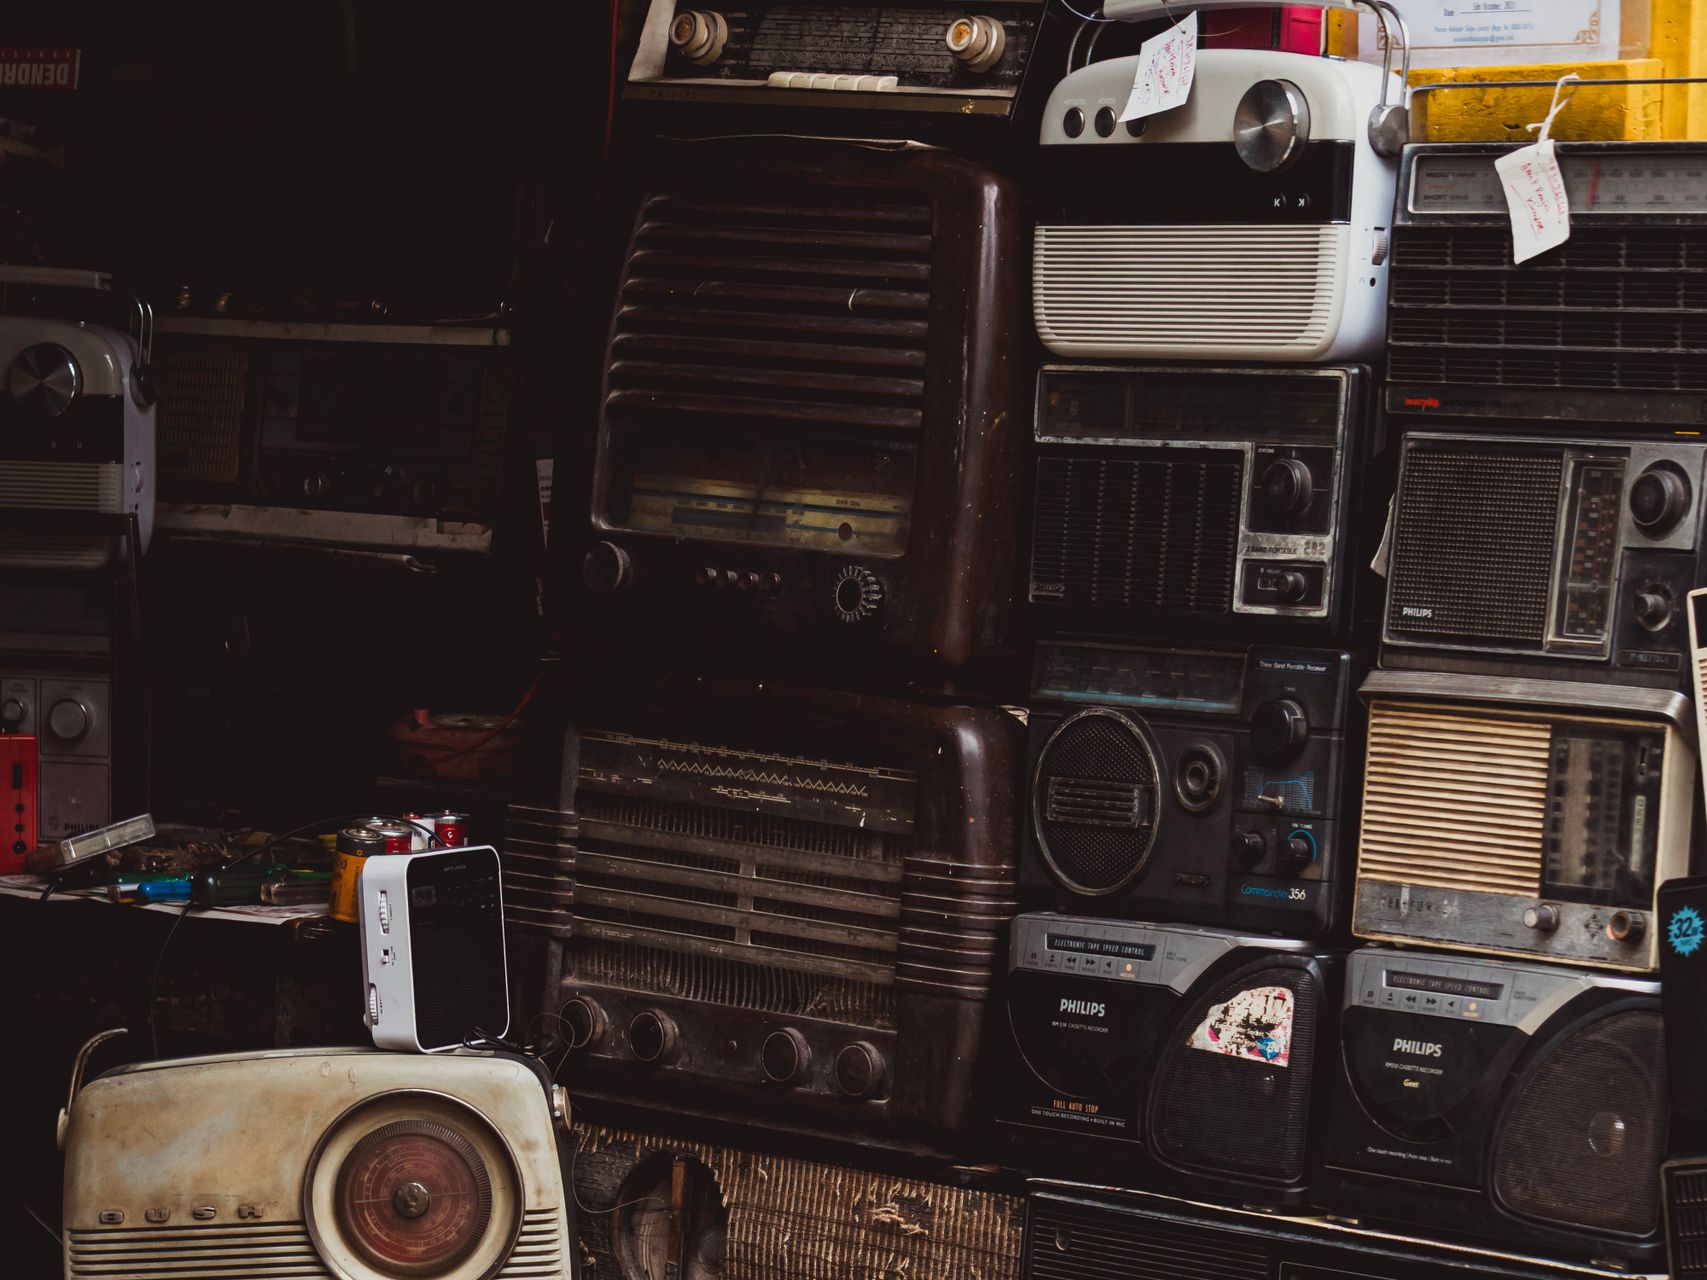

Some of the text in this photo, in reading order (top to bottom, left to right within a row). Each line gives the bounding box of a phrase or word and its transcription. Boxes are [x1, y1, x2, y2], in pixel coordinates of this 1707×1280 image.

[1402, 606, 1433, 619] PHILIPS
[1054, 938, 1145, 956] ELECTRONIC TAPE SPEED CONTROL
[1392, 975, 1490, 996] ELECTRONIC TAPE SPEED CONTROL
[1059, 998, 1106, 1018] PHILIPS
[1392, 1037, 1443, 1058] PHILIPS
[1042, 1110, 1060, 1118] TOUCH
[1060, 1112, 1090, 1122] RECORDING
[1052, 1099, 1099, 1114] FULL AUTO STOP
[99, 1201, 264, 1224] BUSH
